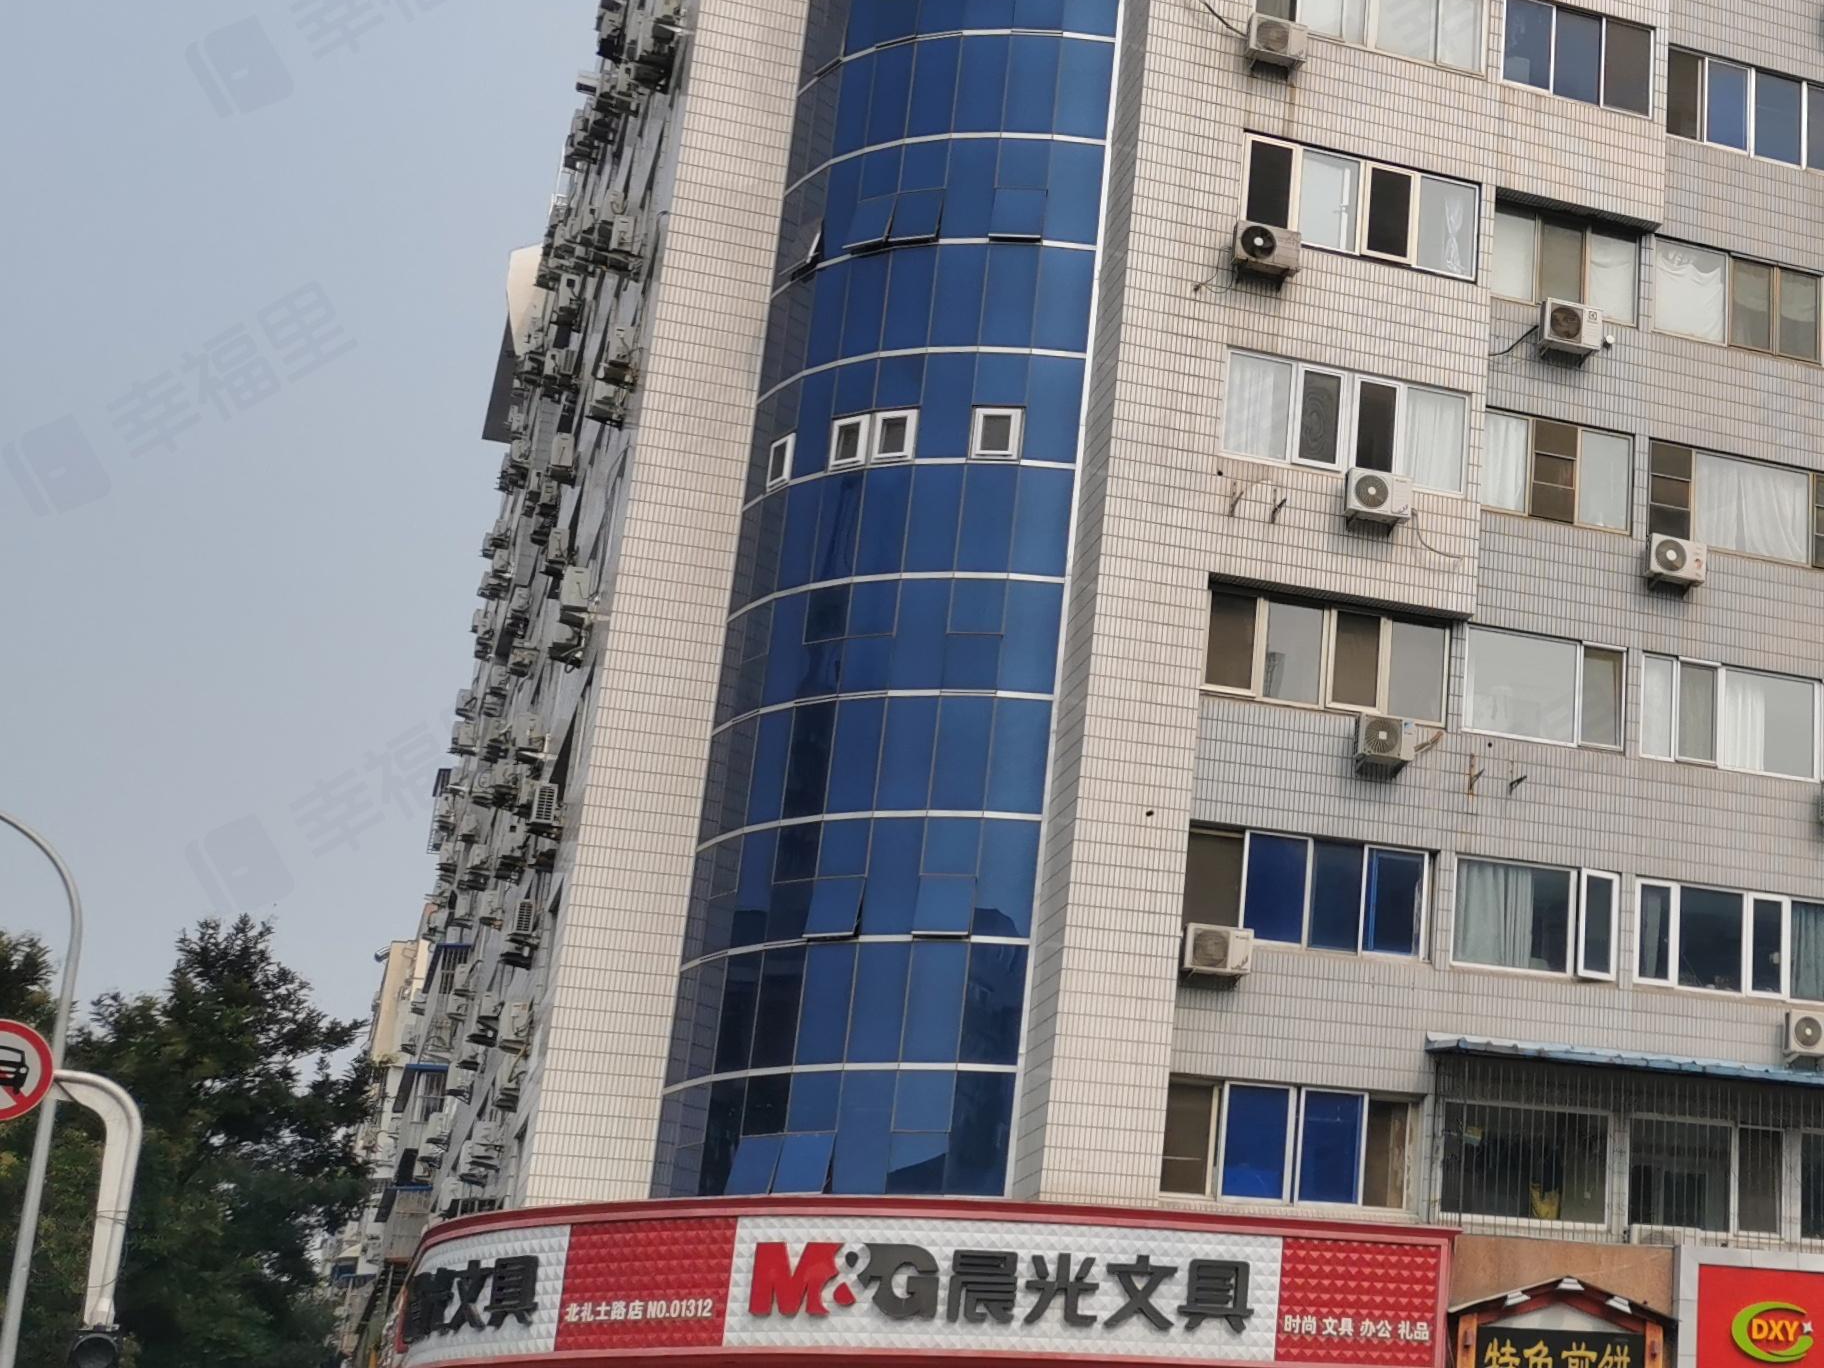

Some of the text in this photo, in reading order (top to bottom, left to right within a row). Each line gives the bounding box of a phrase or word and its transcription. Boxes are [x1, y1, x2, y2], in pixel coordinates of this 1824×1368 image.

[946, 1249, 1254, 1332] 晨光文具
[647, 1298, 713, 1319] NO.01312
[1284, 1314, 1430, 1340] 时尚 文具 办公 礼品
[1751, 1318, 1798, 1342] DXY
